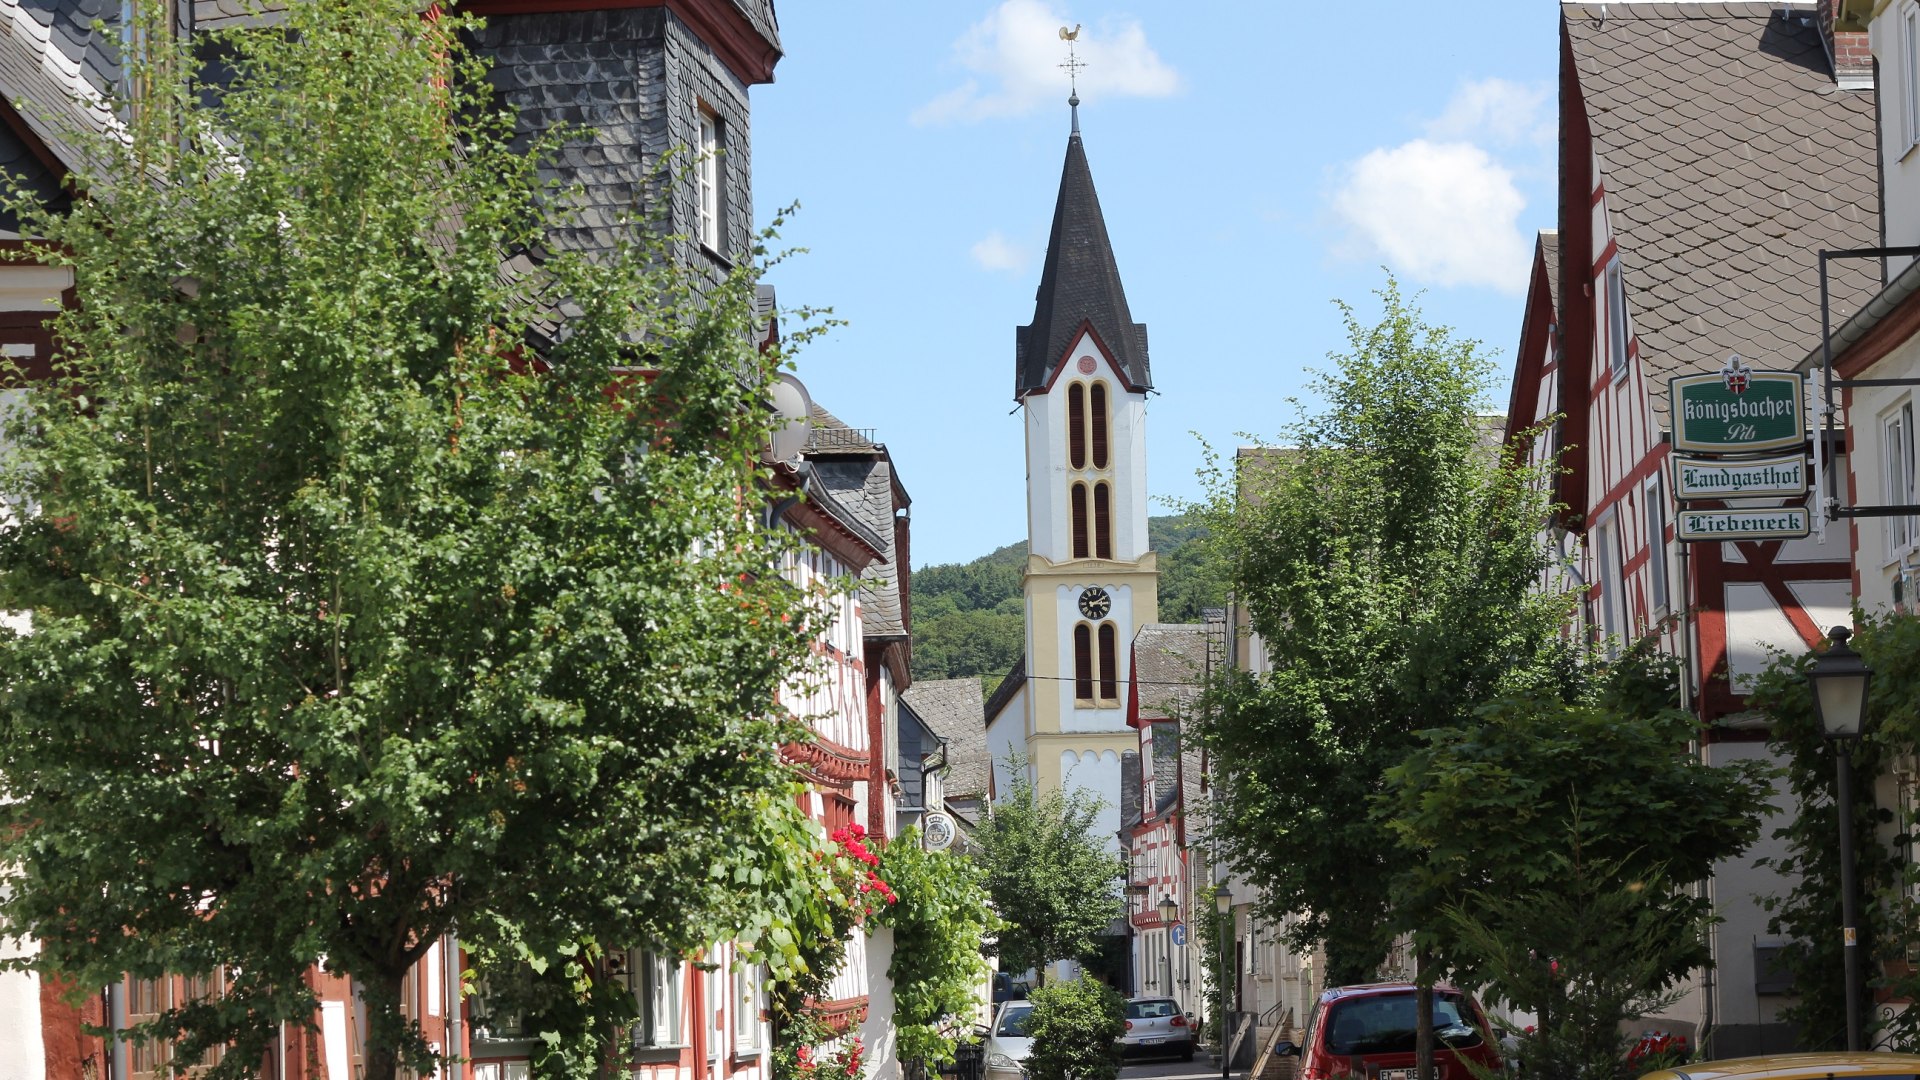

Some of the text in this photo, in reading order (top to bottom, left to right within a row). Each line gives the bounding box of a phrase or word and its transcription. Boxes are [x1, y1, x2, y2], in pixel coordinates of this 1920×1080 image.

[1685, 396, 1793, 422] Königsbacher
[1724, 423, 1756, 440] Pils
[1684, 466, 1799, 490] Landgasthof
[1689, 514, 1800, 532] Liebeneck
